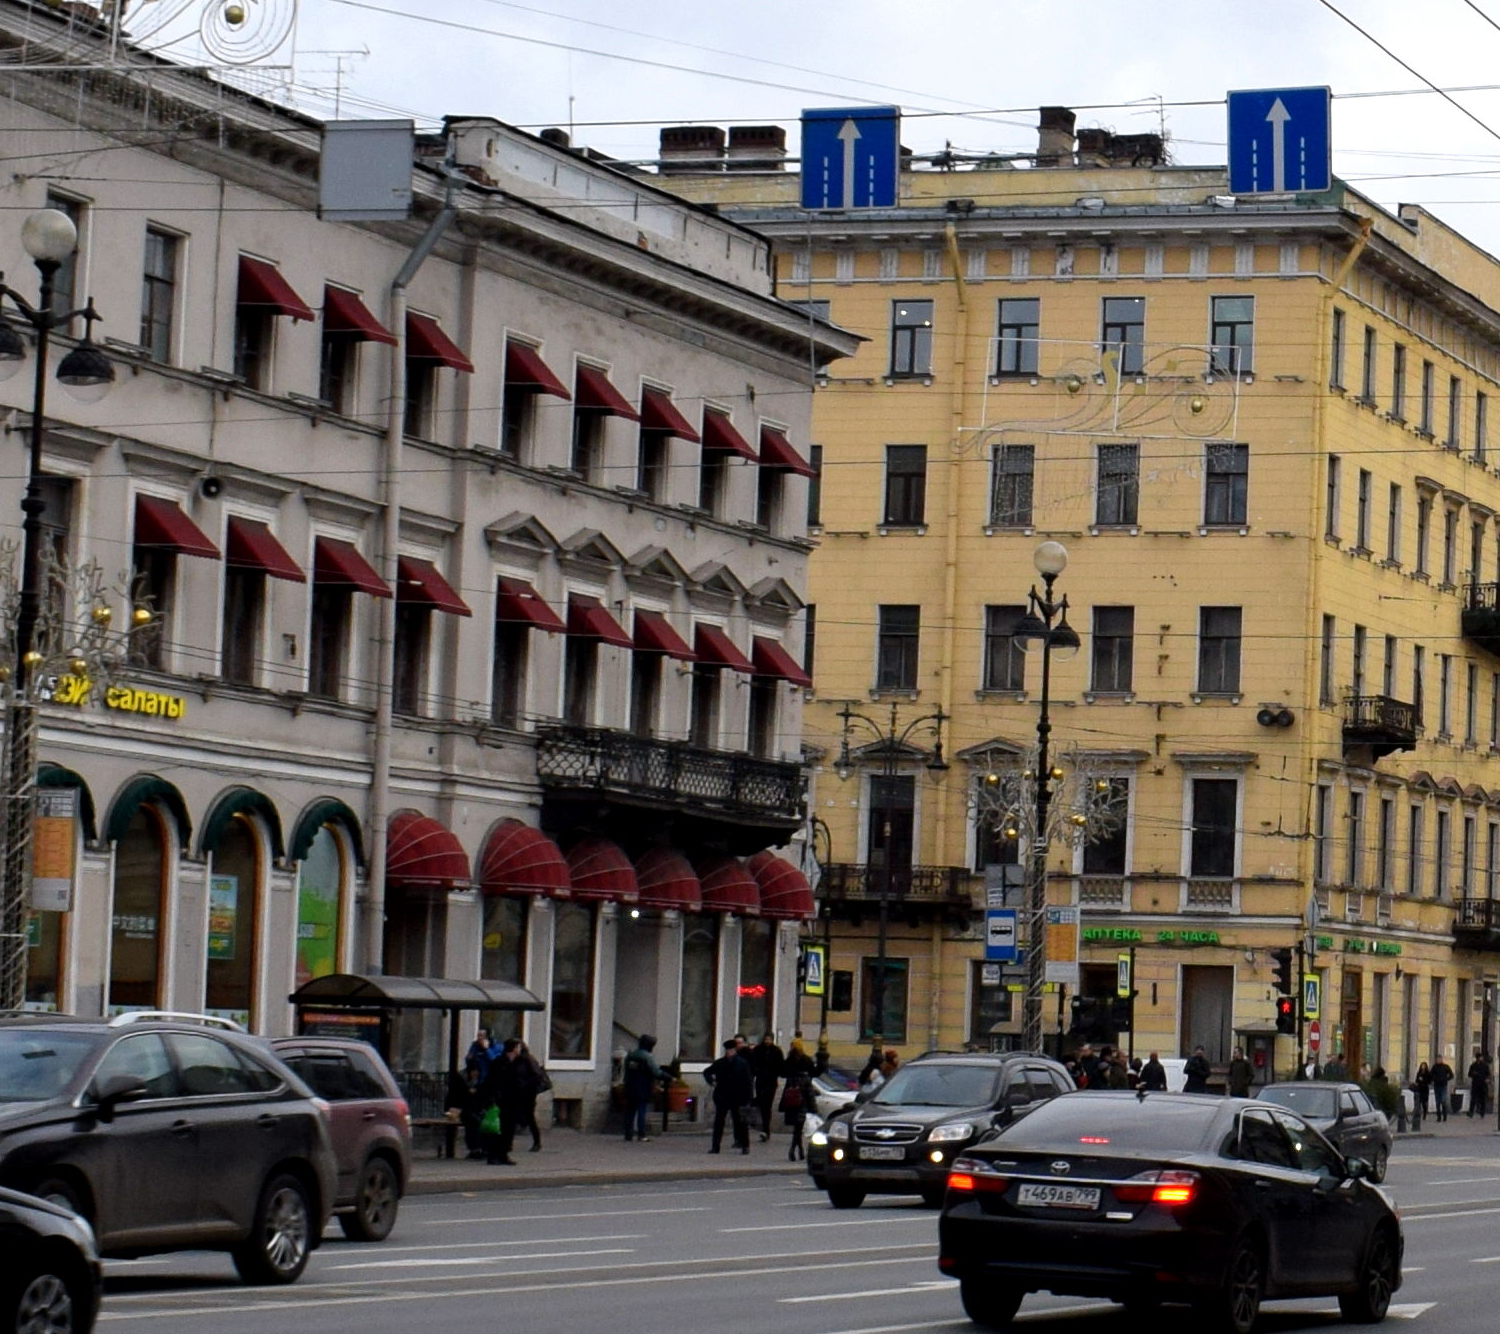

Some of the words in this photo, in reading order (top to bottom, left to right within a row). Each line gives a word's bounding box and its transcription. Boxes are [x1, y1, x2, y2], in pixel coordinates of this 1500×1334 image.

[106, 686, 187, 719] салаты
[1082, 927, 1142, 941] АПТЕКА
[1157, 930, 1174, 941] 24
[1180, 930, 1219, 943] ЧАСА
[1076, 1188, 1097, 1200] 799
